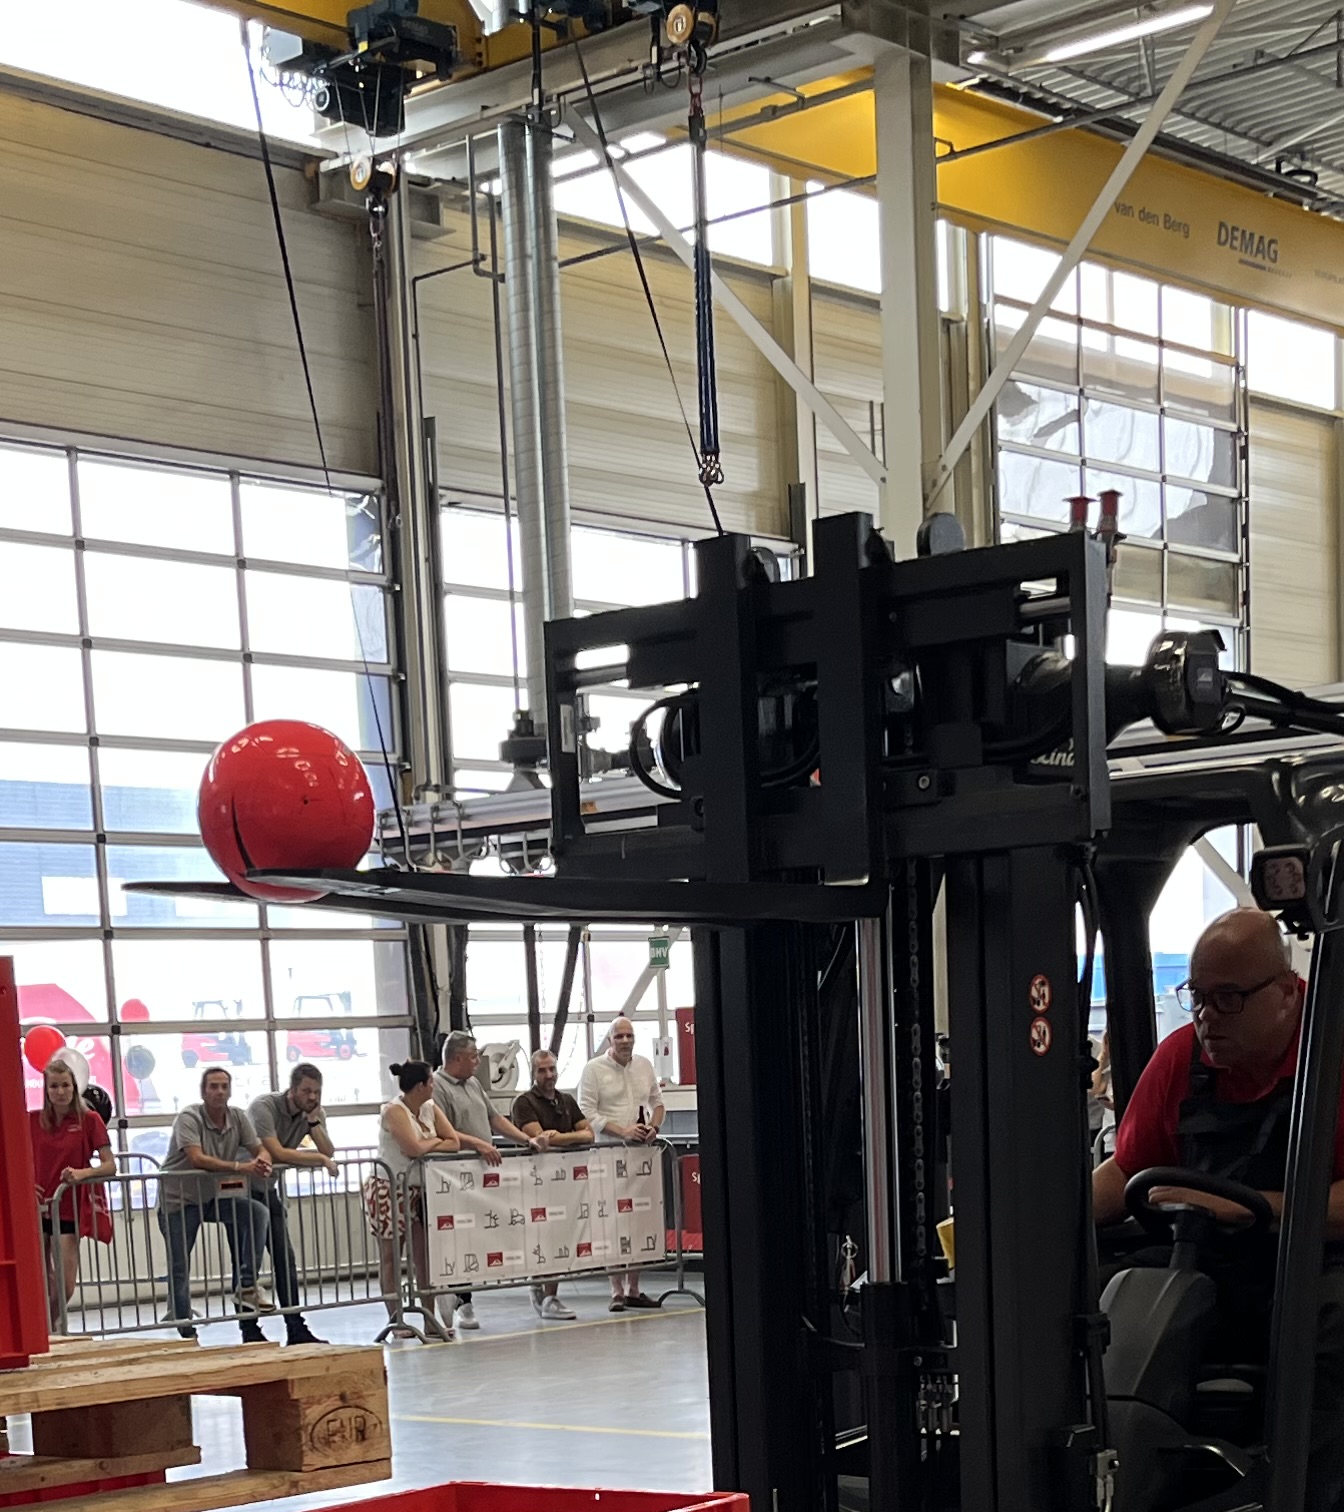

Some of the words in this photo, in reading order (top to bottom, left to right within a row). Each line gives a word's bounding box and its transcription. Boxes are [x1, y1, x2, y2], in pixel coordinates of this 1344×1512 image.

[1114, 200, 1135, 219] van
[1138, 206, 1160, 227] den
[1163, 212, 1190, 238] Berg
[1217, 220, 1279, 264] DEMAG
